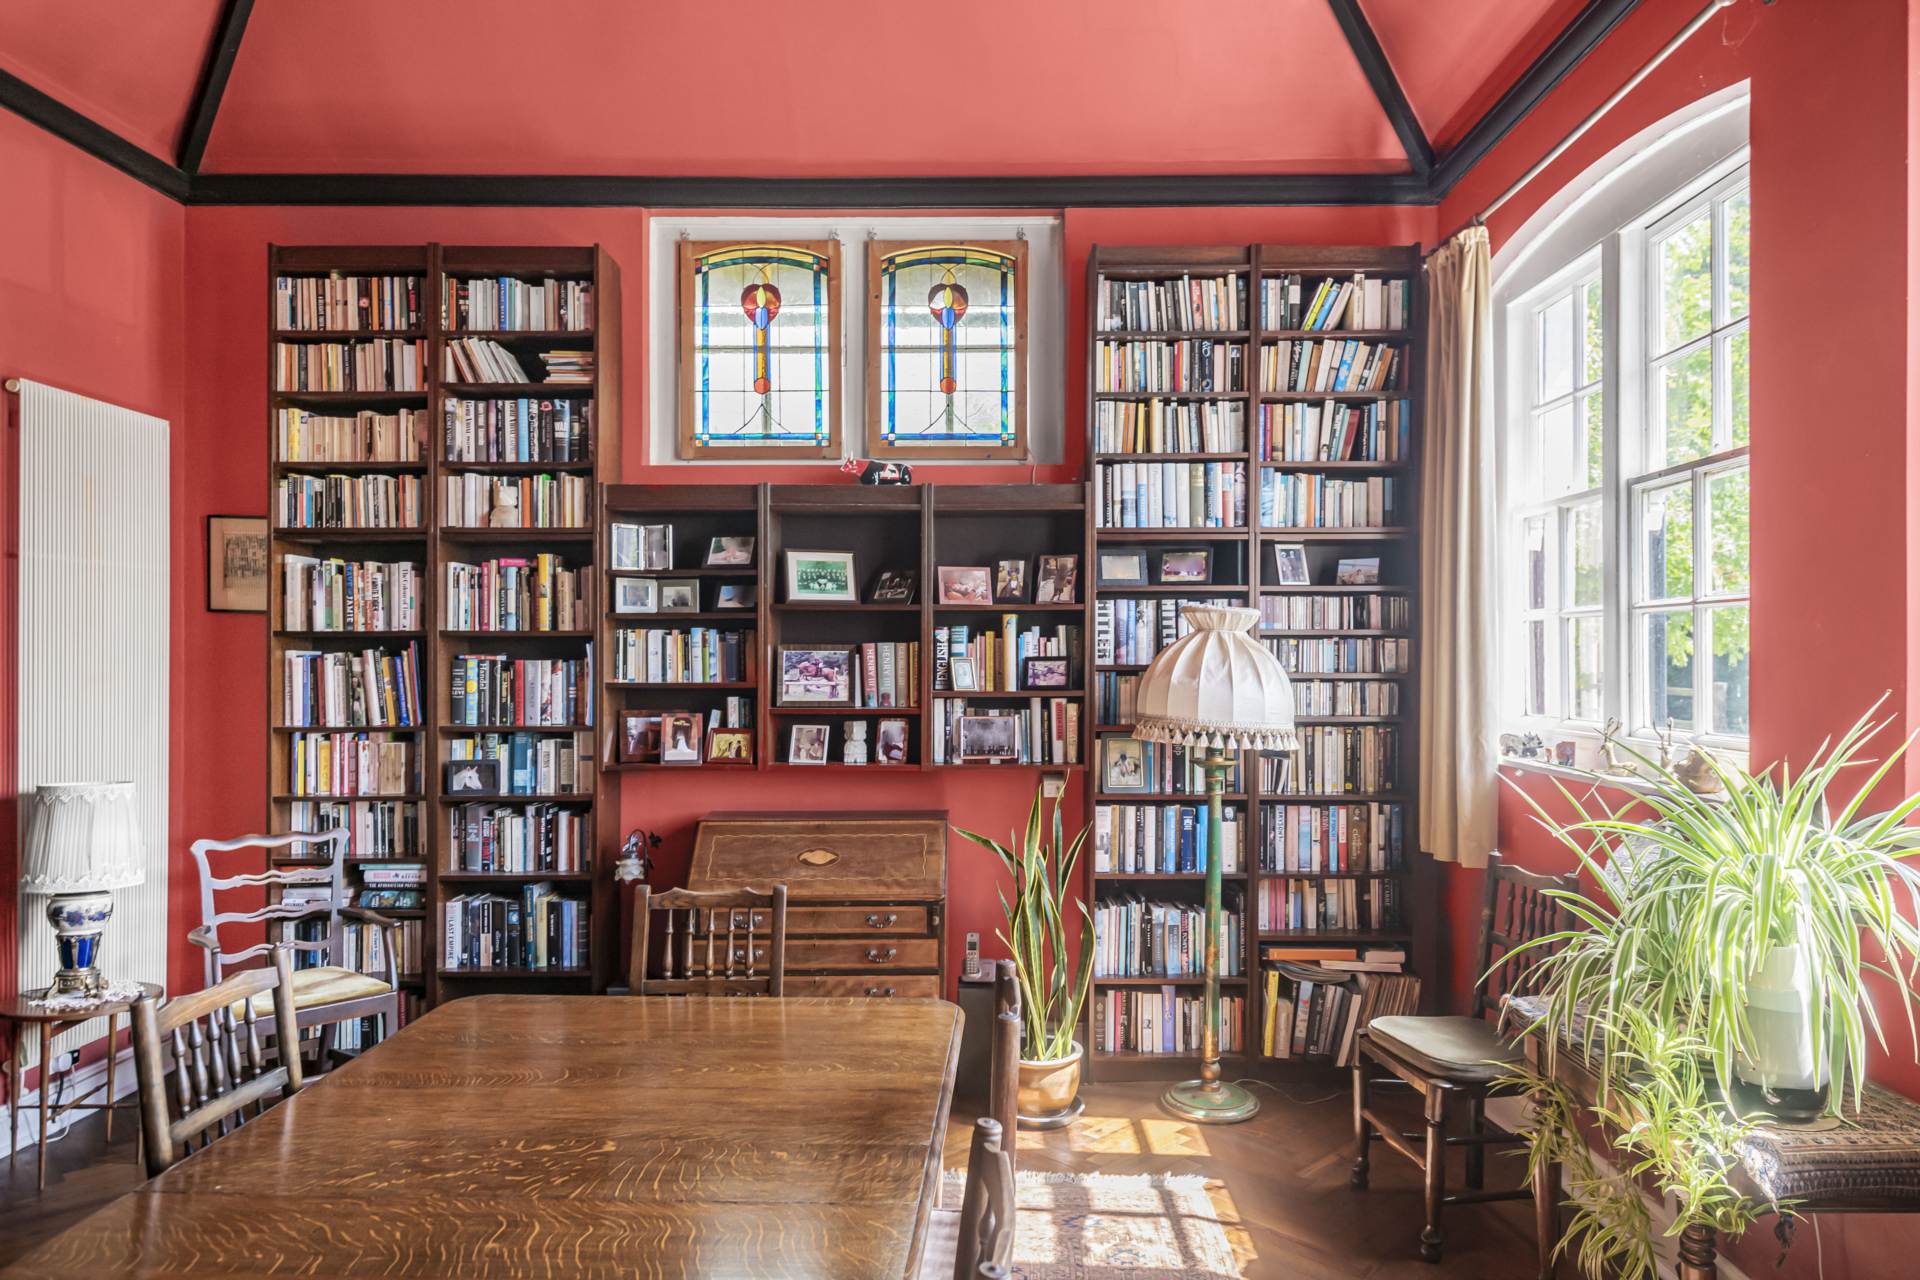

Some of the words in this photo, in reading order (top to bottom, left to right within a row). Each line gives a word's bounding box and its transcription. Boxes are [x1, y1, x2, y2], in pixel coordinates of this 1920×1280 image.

[345, 595, 354, 623] JAMIE
[1097, 599, 1112, 660] HITLER
[866, 648, 876, 676] HENRY
[882, 645, 891, 676] HENRY
[936, 640, 950, 682] ENGLISH
[447, 920, 455, 936] LAST
[447, 936, 455, 961] EMPIRE
